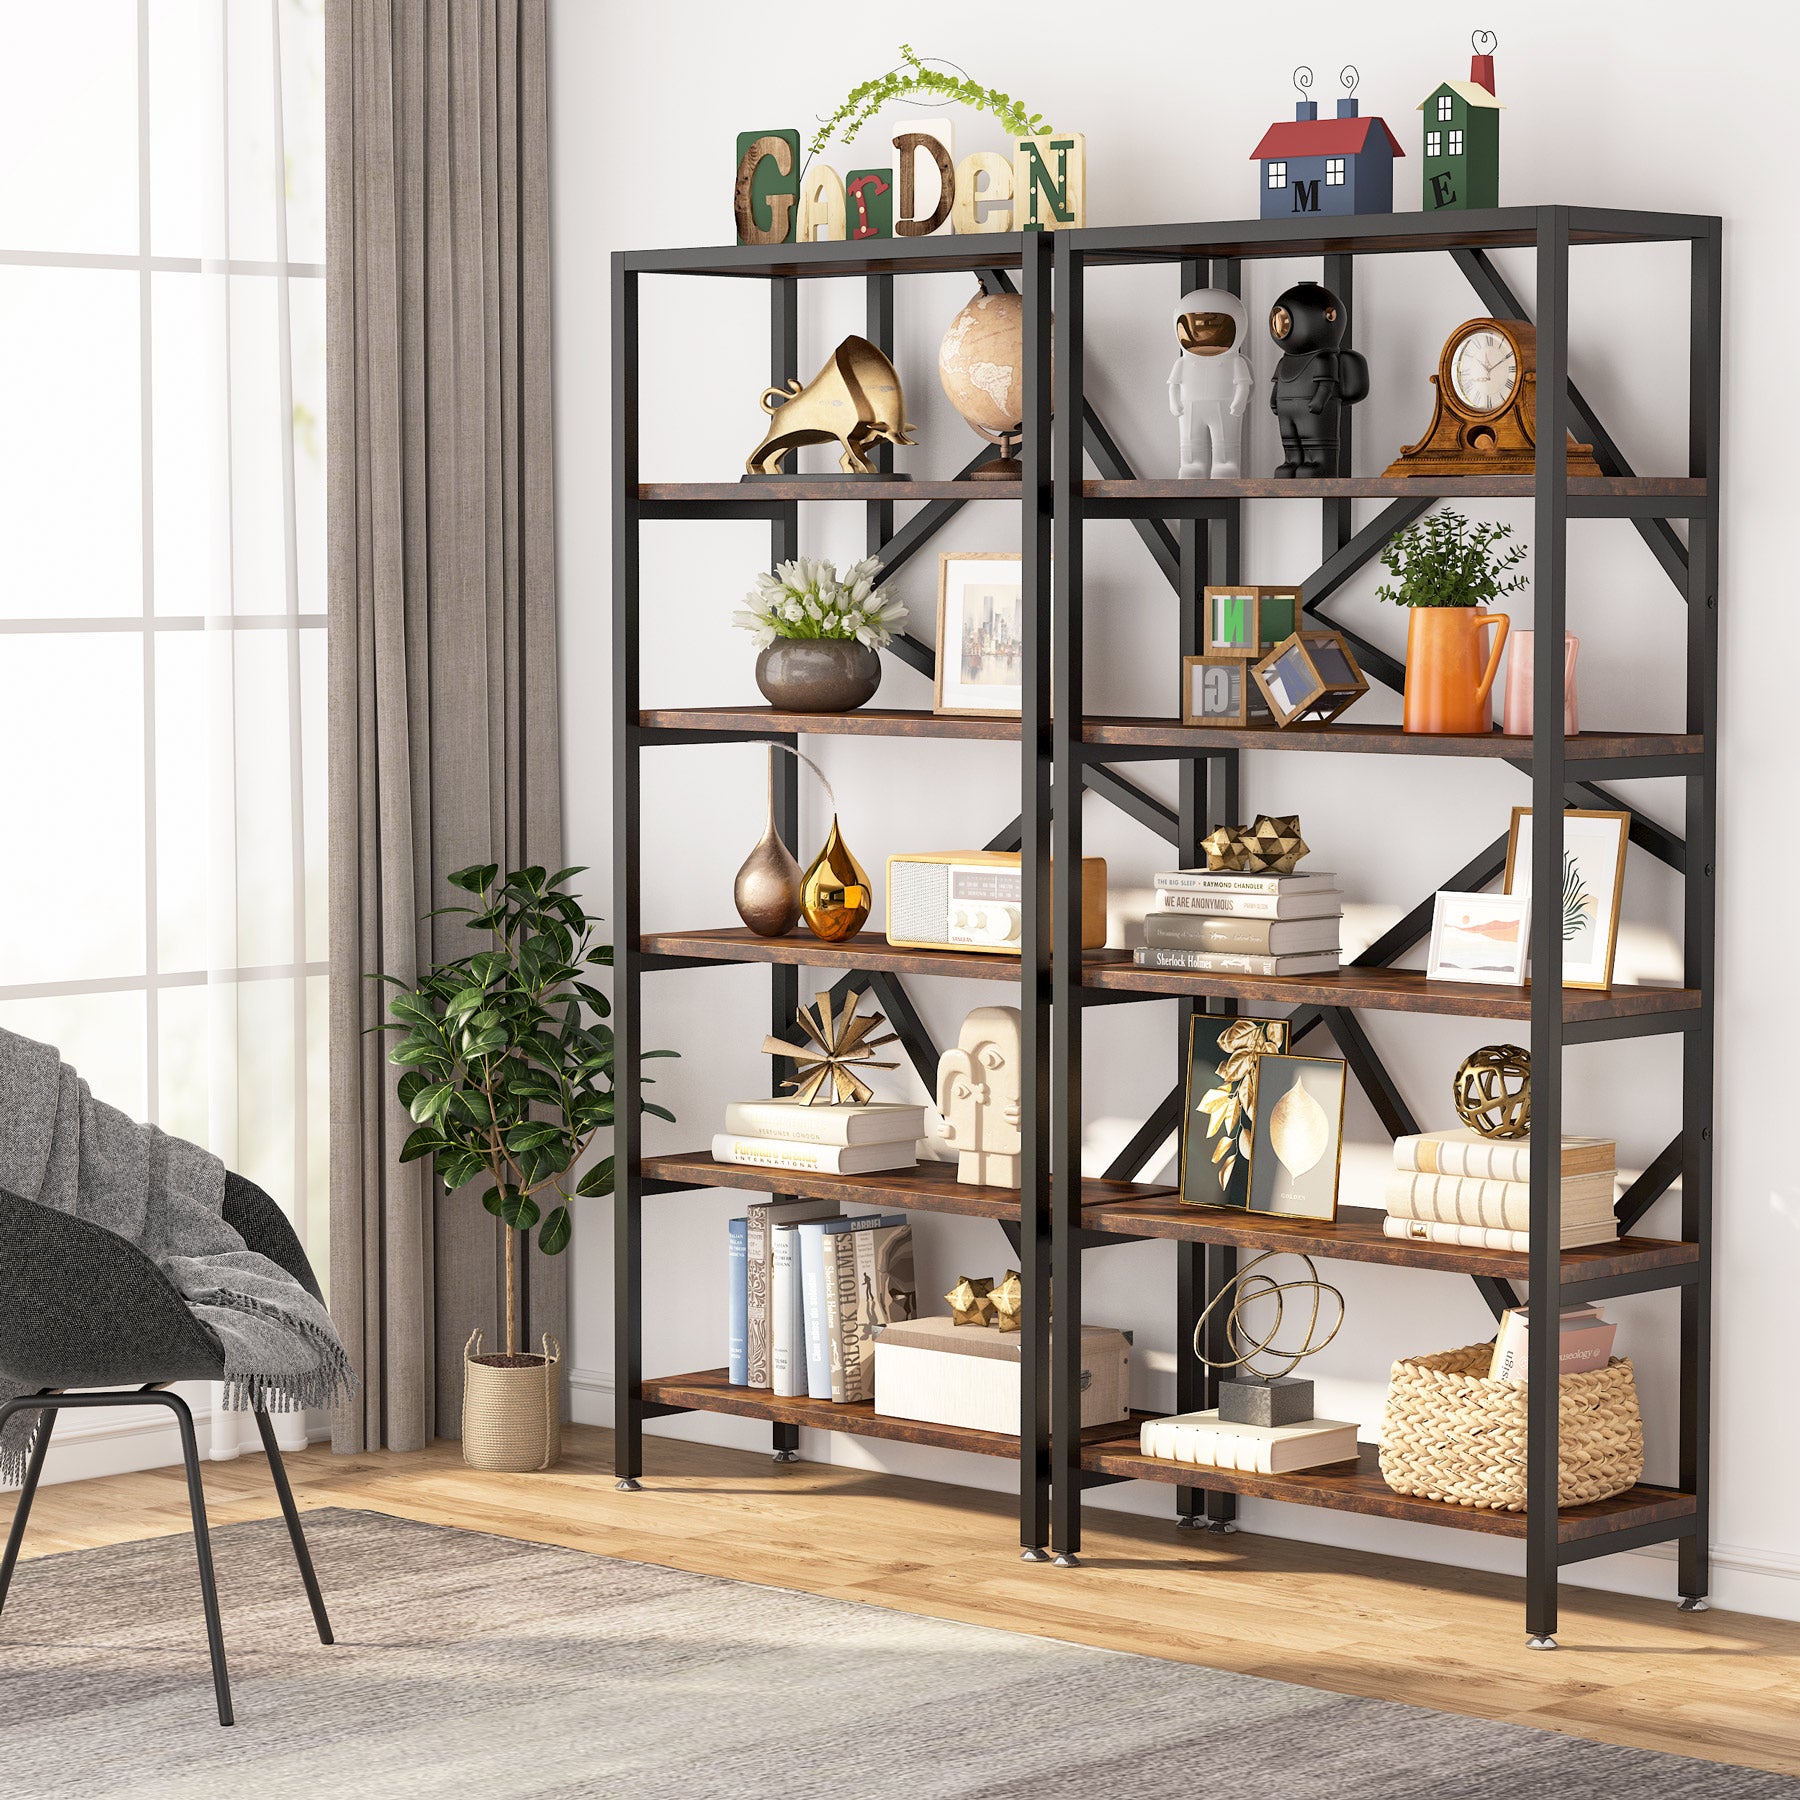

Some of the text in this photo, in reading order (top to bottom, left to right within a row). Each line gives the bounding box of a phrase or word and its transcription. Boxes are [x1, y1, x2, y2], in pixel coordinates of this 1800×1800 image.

[1291, 180, 1321, 213] M
[1429, 171, 1457, 209] E
[1157, 878, 1167, 886] THE
[1202, 881, 1232, 889] RAYMOND
[1233, 882, 1264, 890] CHANDLER
[1164, 895, 1176, 907] WE
[1176, 897, 1190, 908] ARE
[1191, 897, 1234, 911] ANONYMOUS
[1156, 952, 1187, 967] Sherlock
[1187, 956, 1212, 969] Holmes
[824, 1265, 835, 1298] Sherlock
[836, 1233, 863, 1402] SHERLOCK HOLMES
[1560, 1349, 1593, 1362] useology
